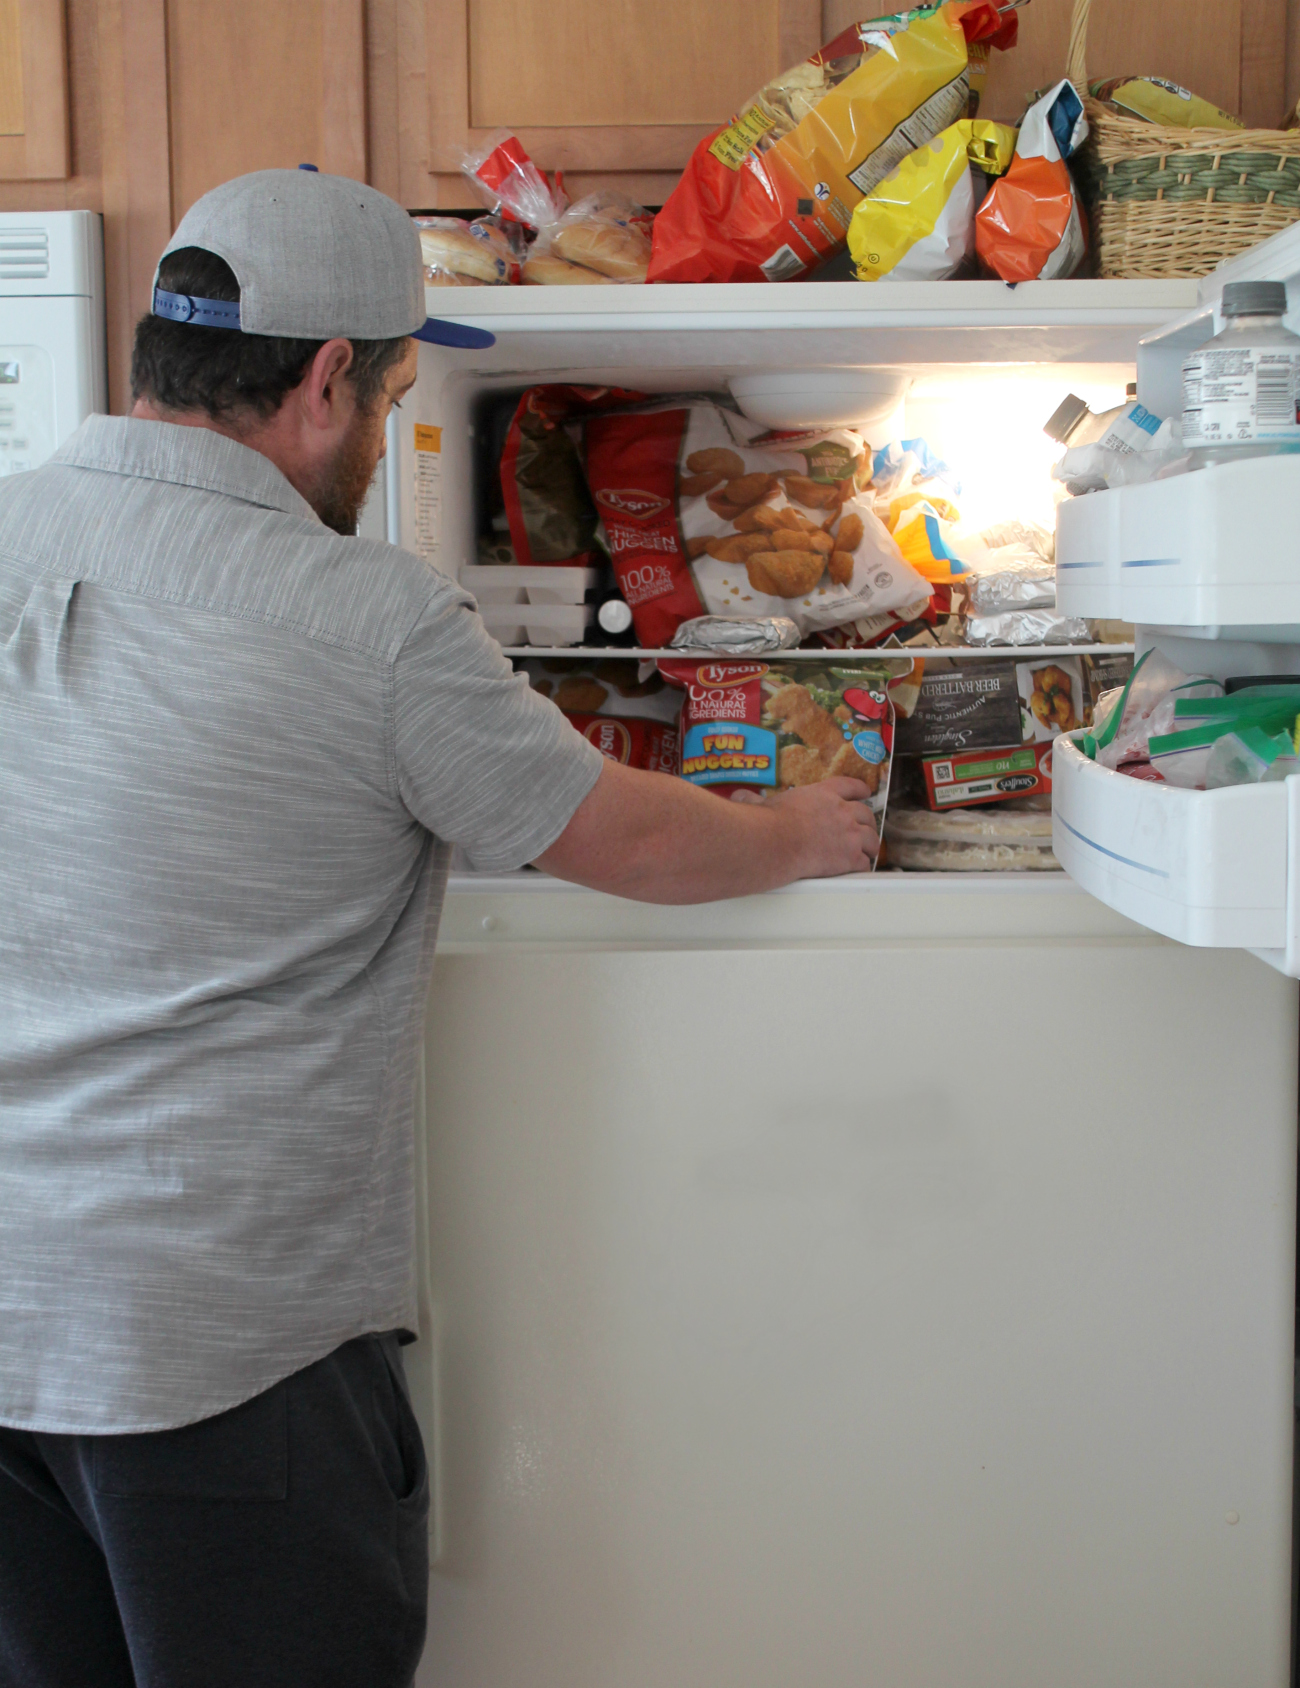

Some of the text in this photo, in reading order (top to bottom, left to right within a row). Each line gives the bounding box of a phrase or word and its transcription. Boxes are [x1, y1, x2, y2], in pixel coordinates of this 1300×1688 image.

[608, 492, 662, 511] Tyson
[620, 565, 672, 592] 100%
[706, 663, 762, 682] Tyson
[921, 678, 1001, 697] BEER BATTERED
[701, 700, 746, 710] NATURAL
[944, 695, 986, 721] AUTHENTIC
[925, 713, 942, 722] PUB
[601, 724, 619, 762] yson
[702, 734, 745, 753] FUN
[924, 728, 973, 747] Singleton
[658, 729, 676, 773] ICKEN
[682, 752, 770, 775] NUGGETS
[996, 760, 1011, 771] no
[1000, 776, 1033, 791] Stouffer's
